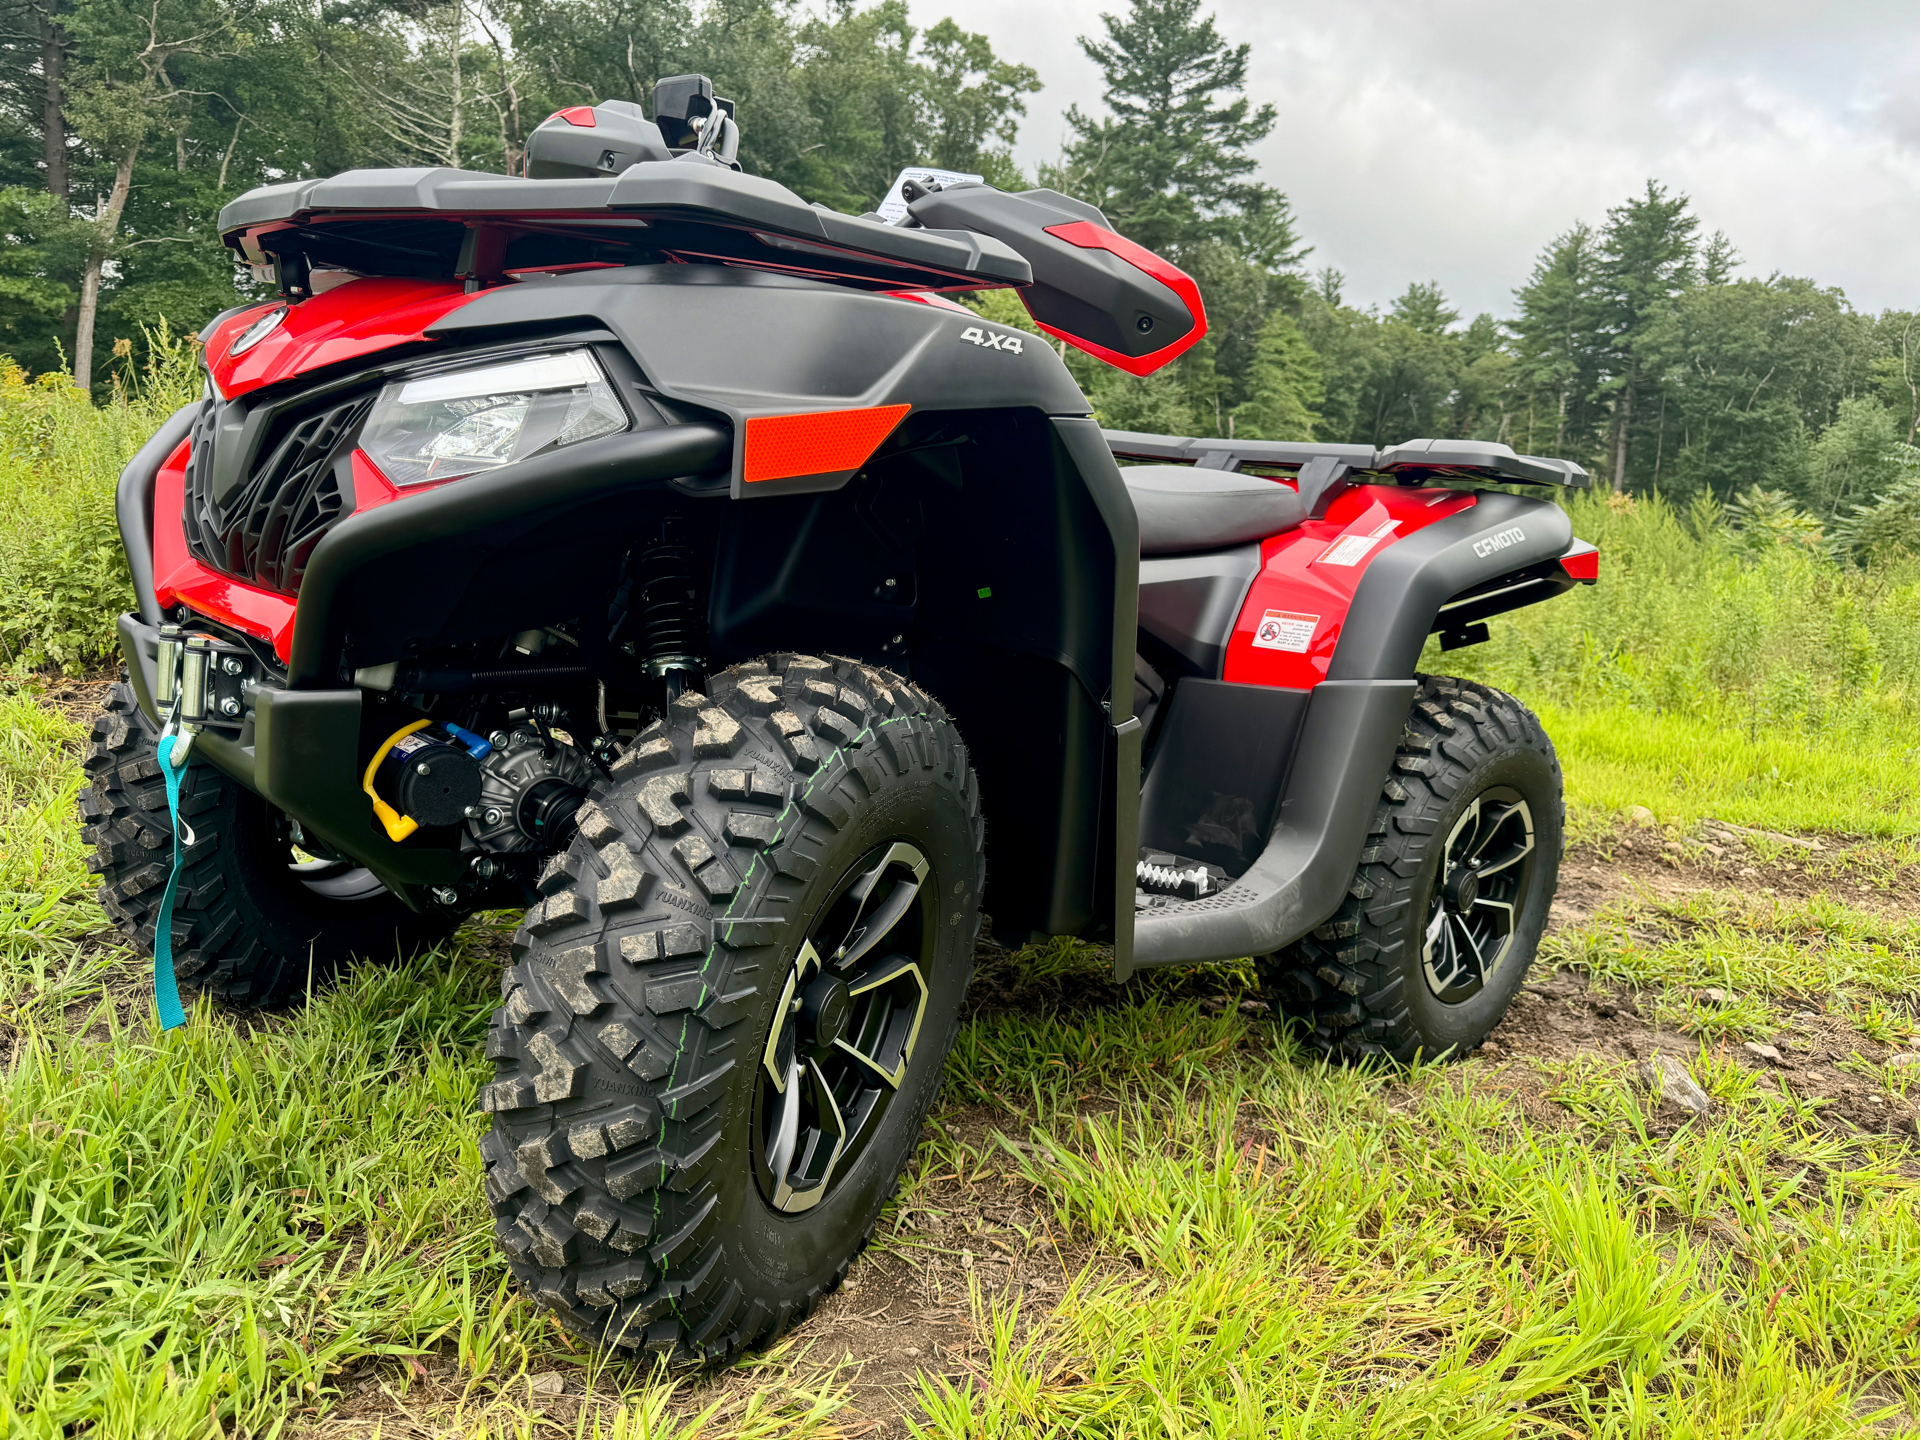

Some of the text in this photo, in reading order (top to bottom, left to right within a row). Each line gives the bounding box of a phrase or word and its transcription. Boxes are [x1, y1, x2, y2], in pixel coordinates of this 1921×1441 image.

[960, 326, 1023, 355] 4X4
[1472, 526, 1526, 559] CFMOTO
[744, 748, 796, 784] YUANXING
[654, 889, 715, 921] YUANXING
[735, 945, 791, 1118] CFMOTO
[592, 1075, 657, 1099] YUANXING
